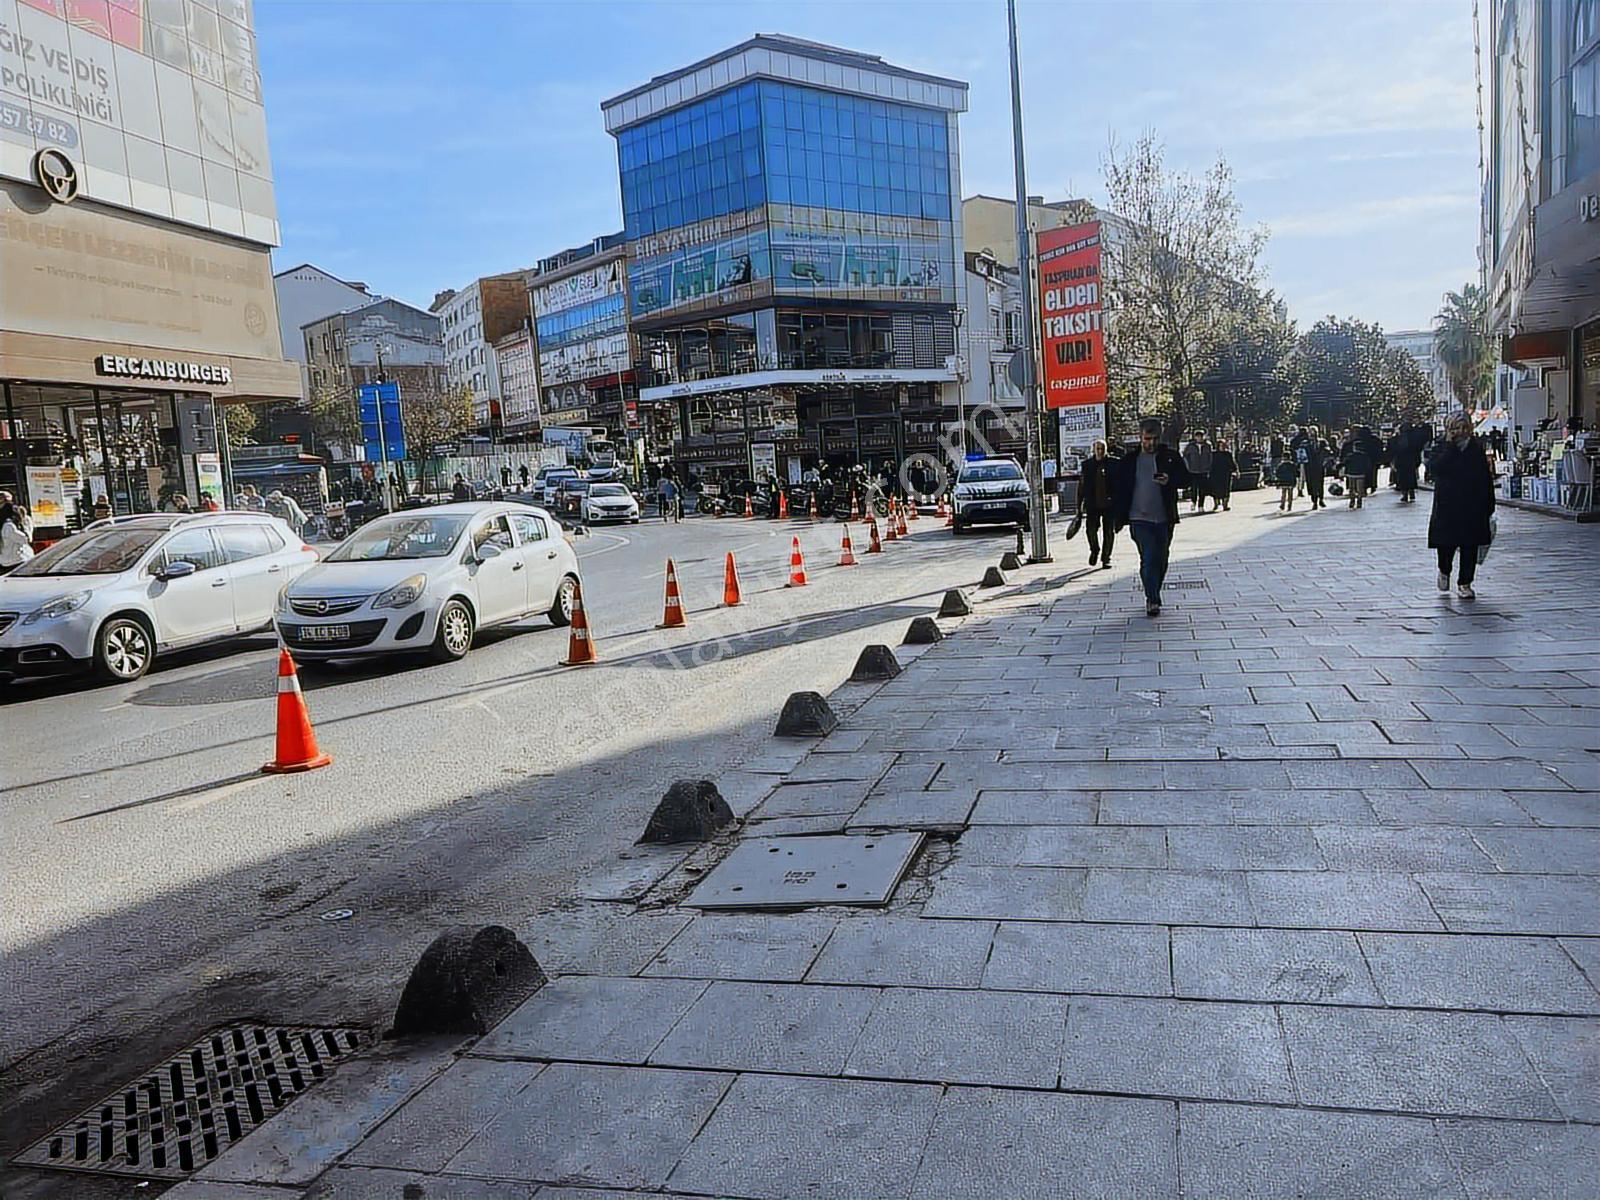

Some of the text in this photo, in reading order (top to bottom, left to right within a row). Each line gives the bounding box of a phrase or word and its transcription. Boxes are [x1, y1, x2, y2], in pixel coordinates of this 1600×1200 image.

[40, 43, 70, 76] VE
[74, 57, 109, 95] DİŞ
[1, 65, 113, 122] POLİKLİNİĞİ
[48, 122, 68, 143] 82
[1055, 339, 1094, 365] VAR!
[101, 354, 233, 383] ERCANBURGER
